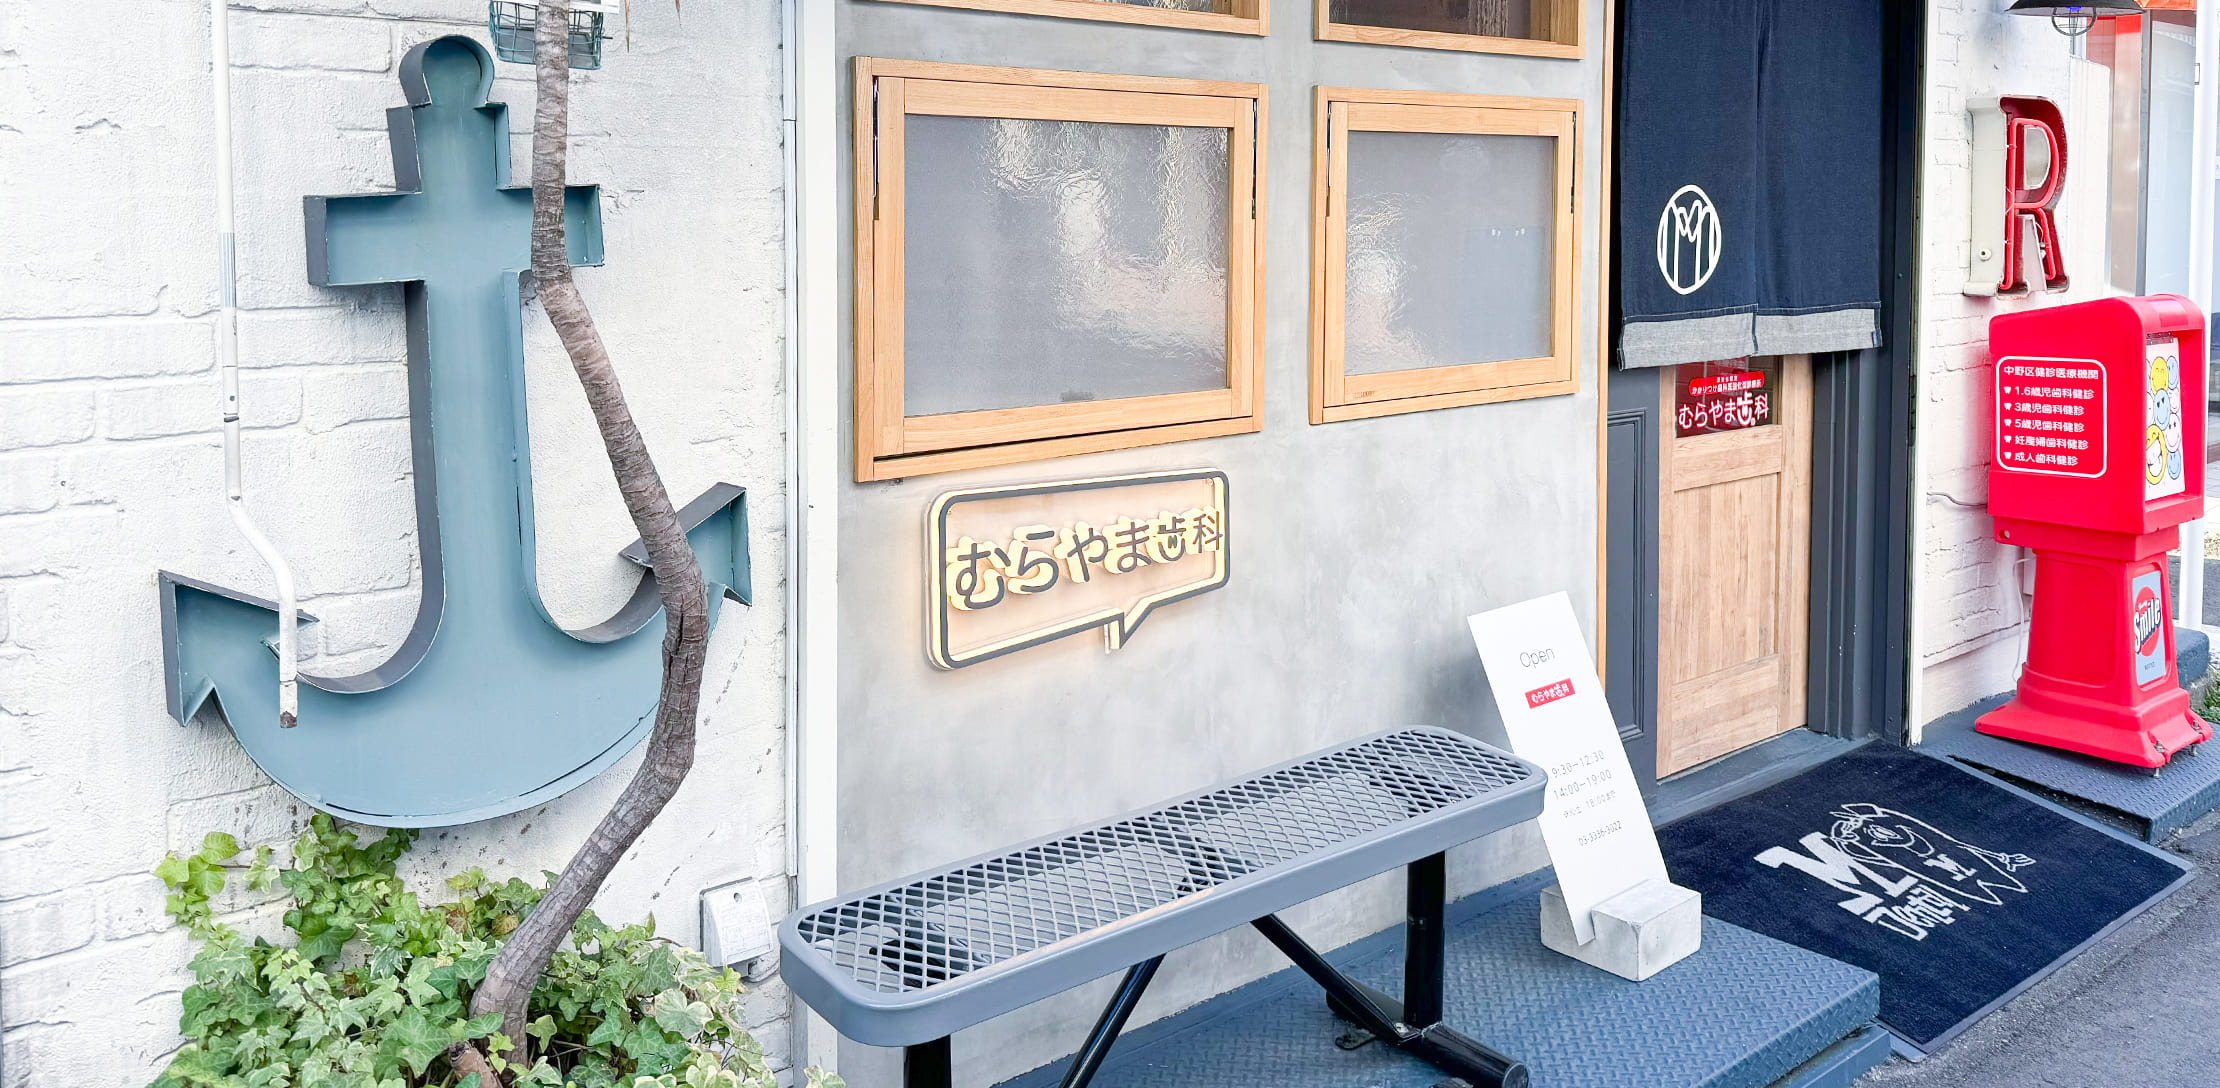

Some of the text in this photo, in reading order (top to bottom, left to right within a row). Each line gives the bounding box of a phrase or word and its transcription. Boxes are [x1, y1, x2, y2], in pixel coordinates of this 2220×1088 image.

[1996, 94, 2069, 300] R
[2003, 366, 2099, 380] 中野区健診医療機関
[2014, 386, 2095, 400] 1.6歳児歯科健診
[1678, 391, 1769, 430] むらやま歯科
[2014, 402, 2085, 416] 3歳児歯科健診
[2014, 418, 2085, 433] 5歳児歯科健診
[2014, 435, 2089, 450] 妊産婦歯科健診
[2014, 452, 2079, 467] 成人歯科健診
[953, 508, 1223, 610] むらやま歯科
[2134, 597, 2161, 655] Smile
[1519, 648, 1556, 669] Open
